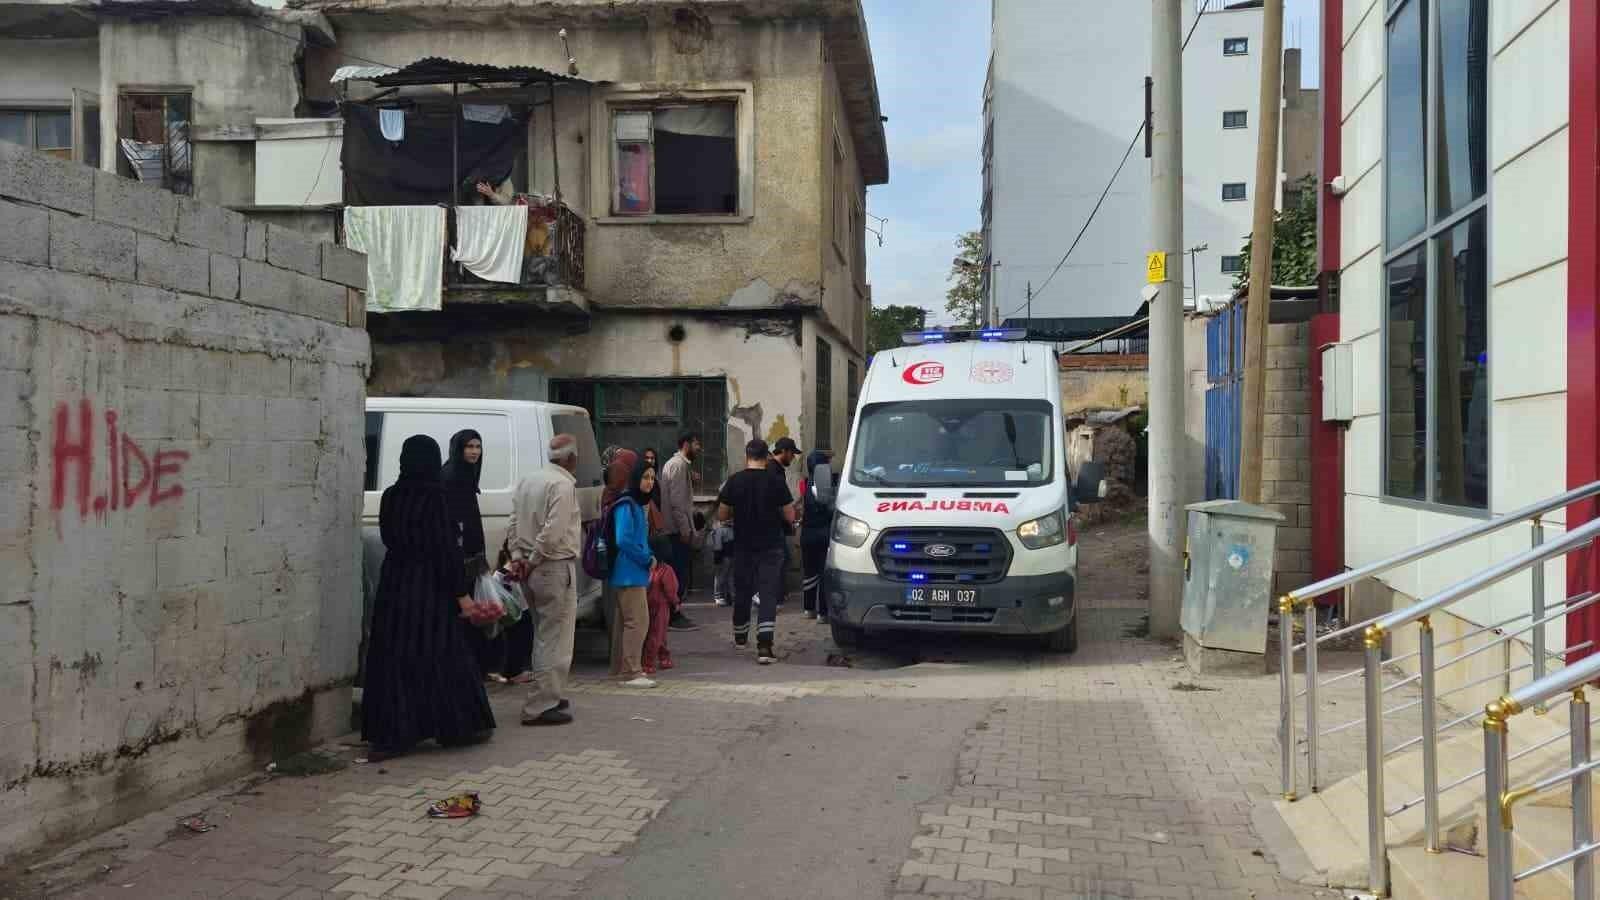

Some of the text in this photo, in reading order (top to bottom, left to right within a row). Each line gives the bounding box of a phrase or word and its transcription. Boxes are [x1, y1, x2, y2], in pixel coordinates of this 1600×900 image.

[912, 589, 976, 602] 02 AGH 037
